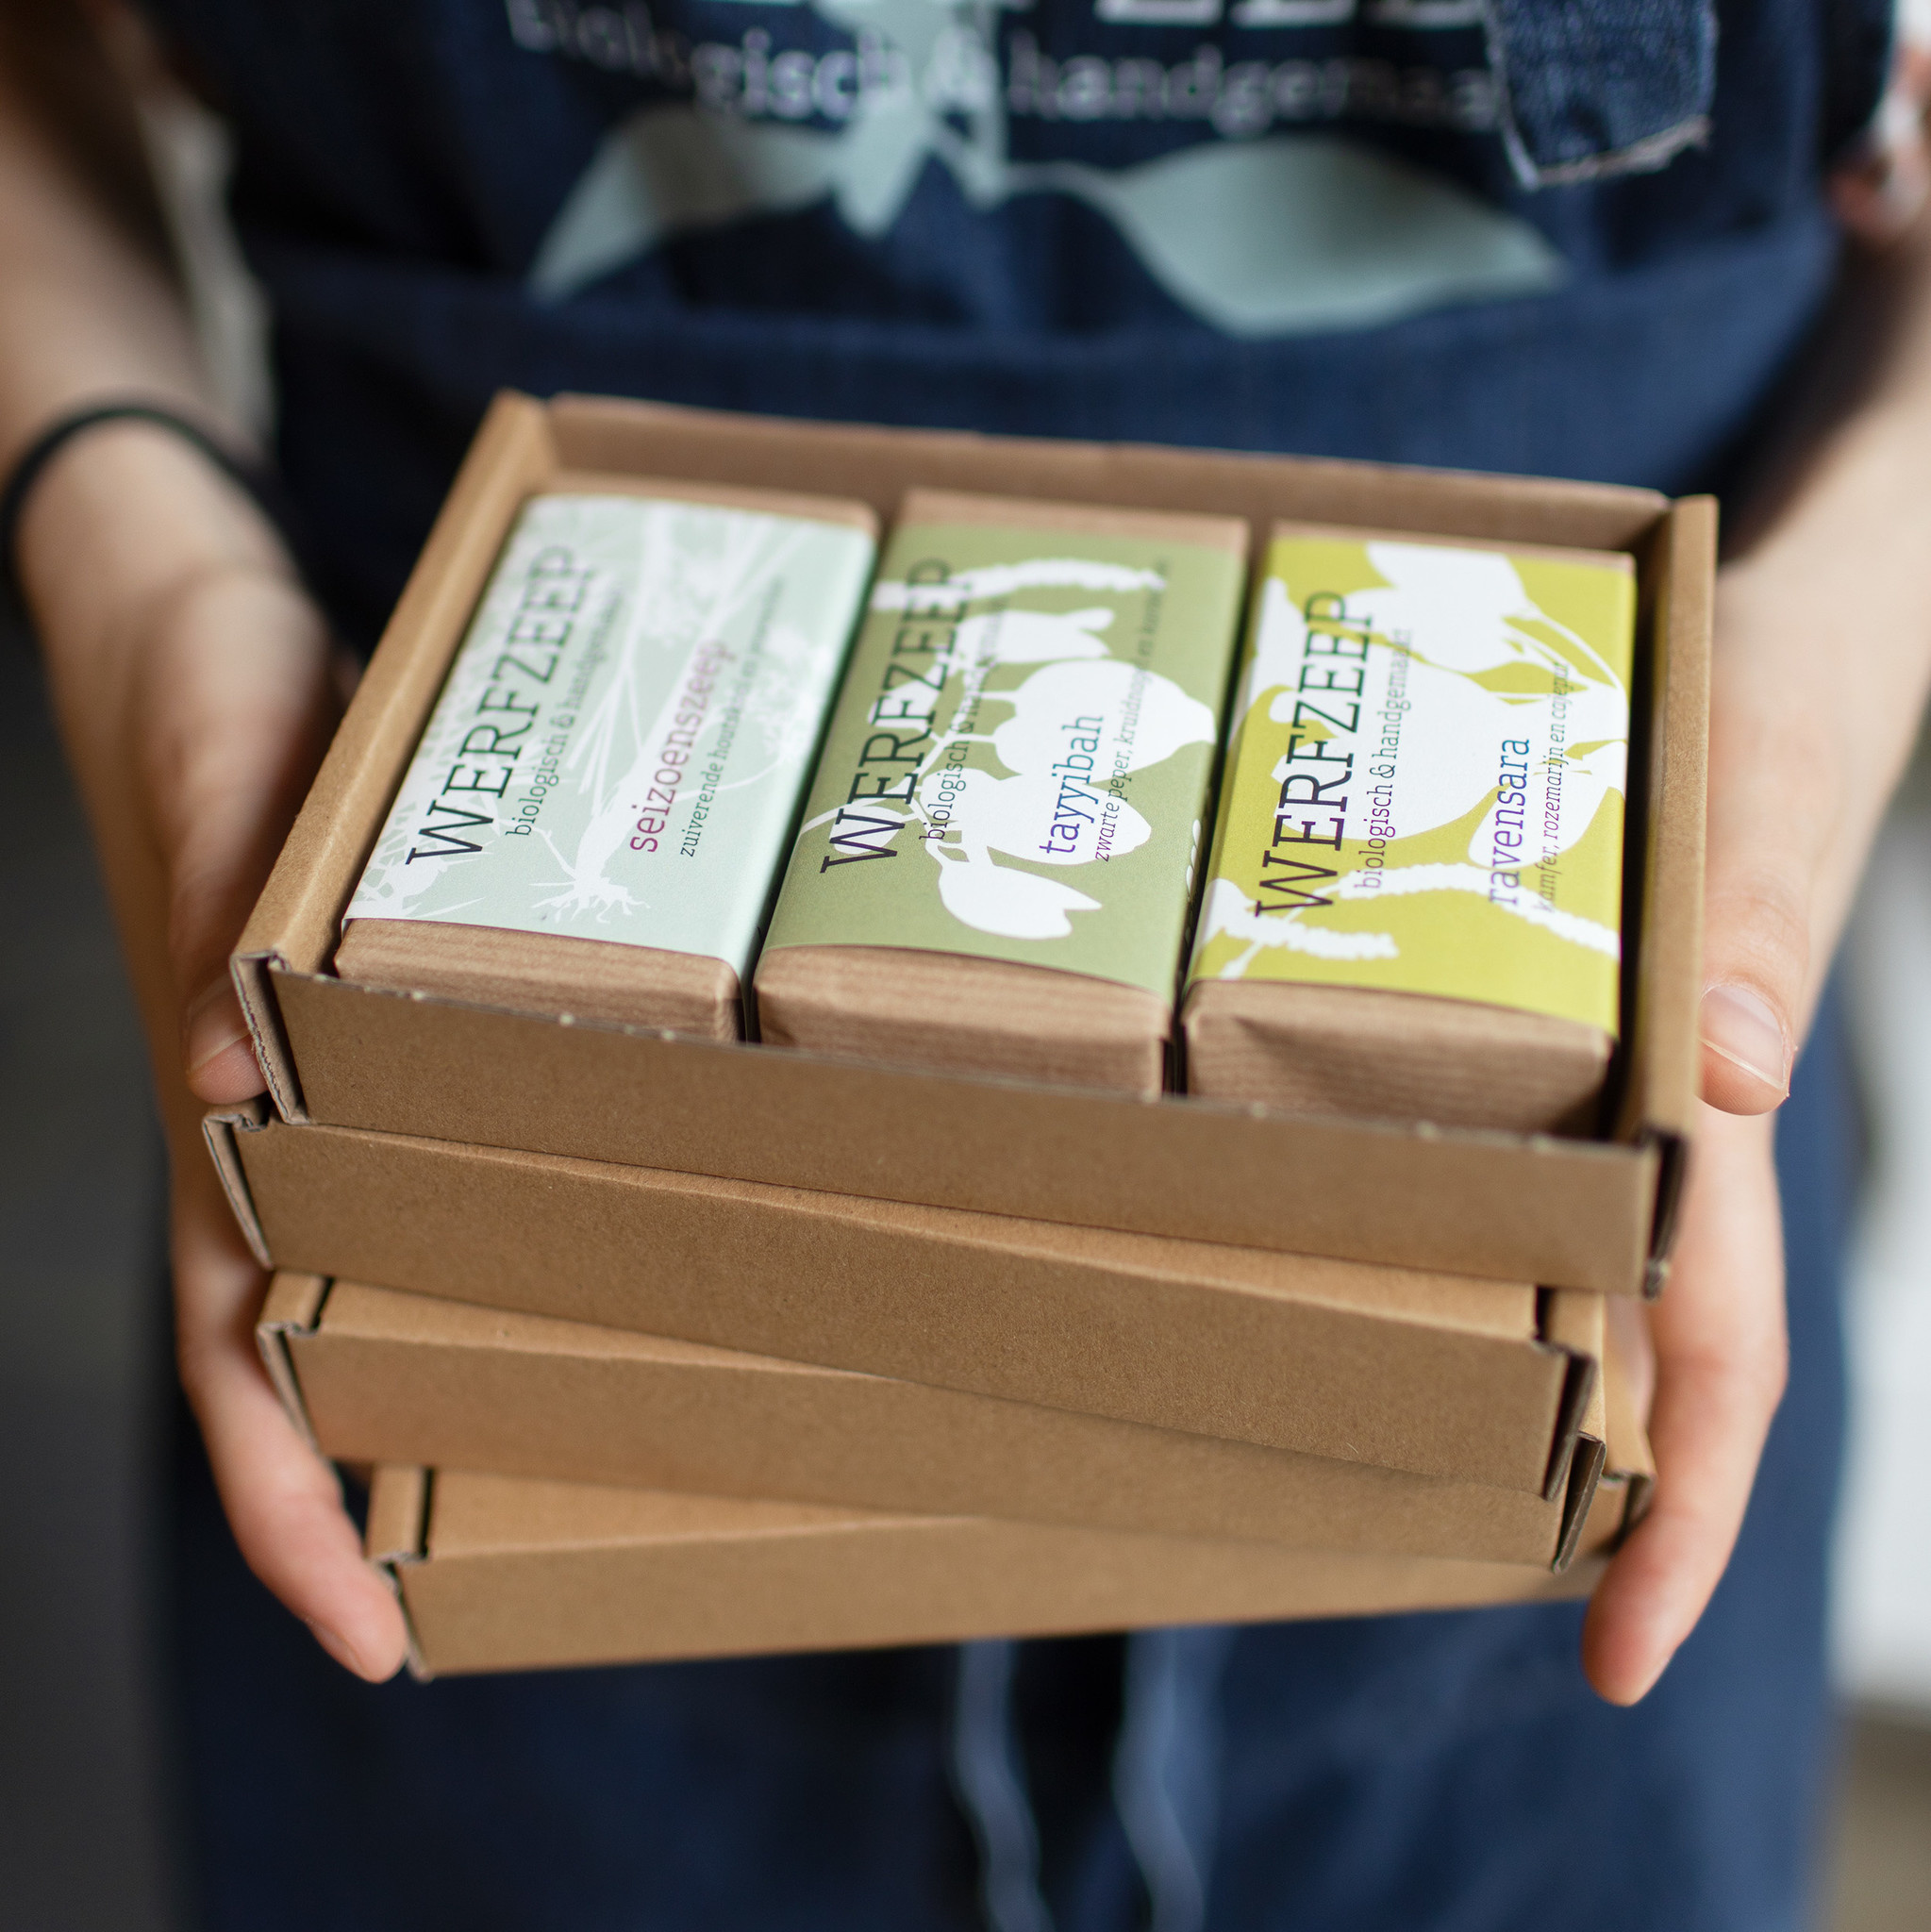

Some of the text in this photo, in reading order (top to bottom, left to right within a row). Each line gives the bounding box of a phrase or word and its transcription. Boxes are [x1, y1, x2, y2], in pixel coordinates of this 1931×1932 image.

[405, 544, 594, 866] WERFZEEP
[629, 639, 738, 854] seizoenszeep
[820, 558, 973, 873] WERFZEEP
[1255, 591, 1373, 917] WERFZEEP
[1354, 627, 1412, 890] biologisch & handgemaakt
[1550, 724, 1567, 744] en
[506, 733, 570, 837] biologisch
[549, 713, 575, 729] &
[680, 761, 724, 858] zuiverende
[919, 740, 970, 841] biologisch
[952, 719, 975, 736] &
[1039, 714, 1104, 855] tayyibah
[1094, 800, 1120, 862] zwarte
[1107, 748, 1133, 802] peper,
[1489, 739, 1530, 906] ravensara
[1542, 747, 1570, 841] rozemarijn
[1533, 844, 1566, 914] kamfer,
